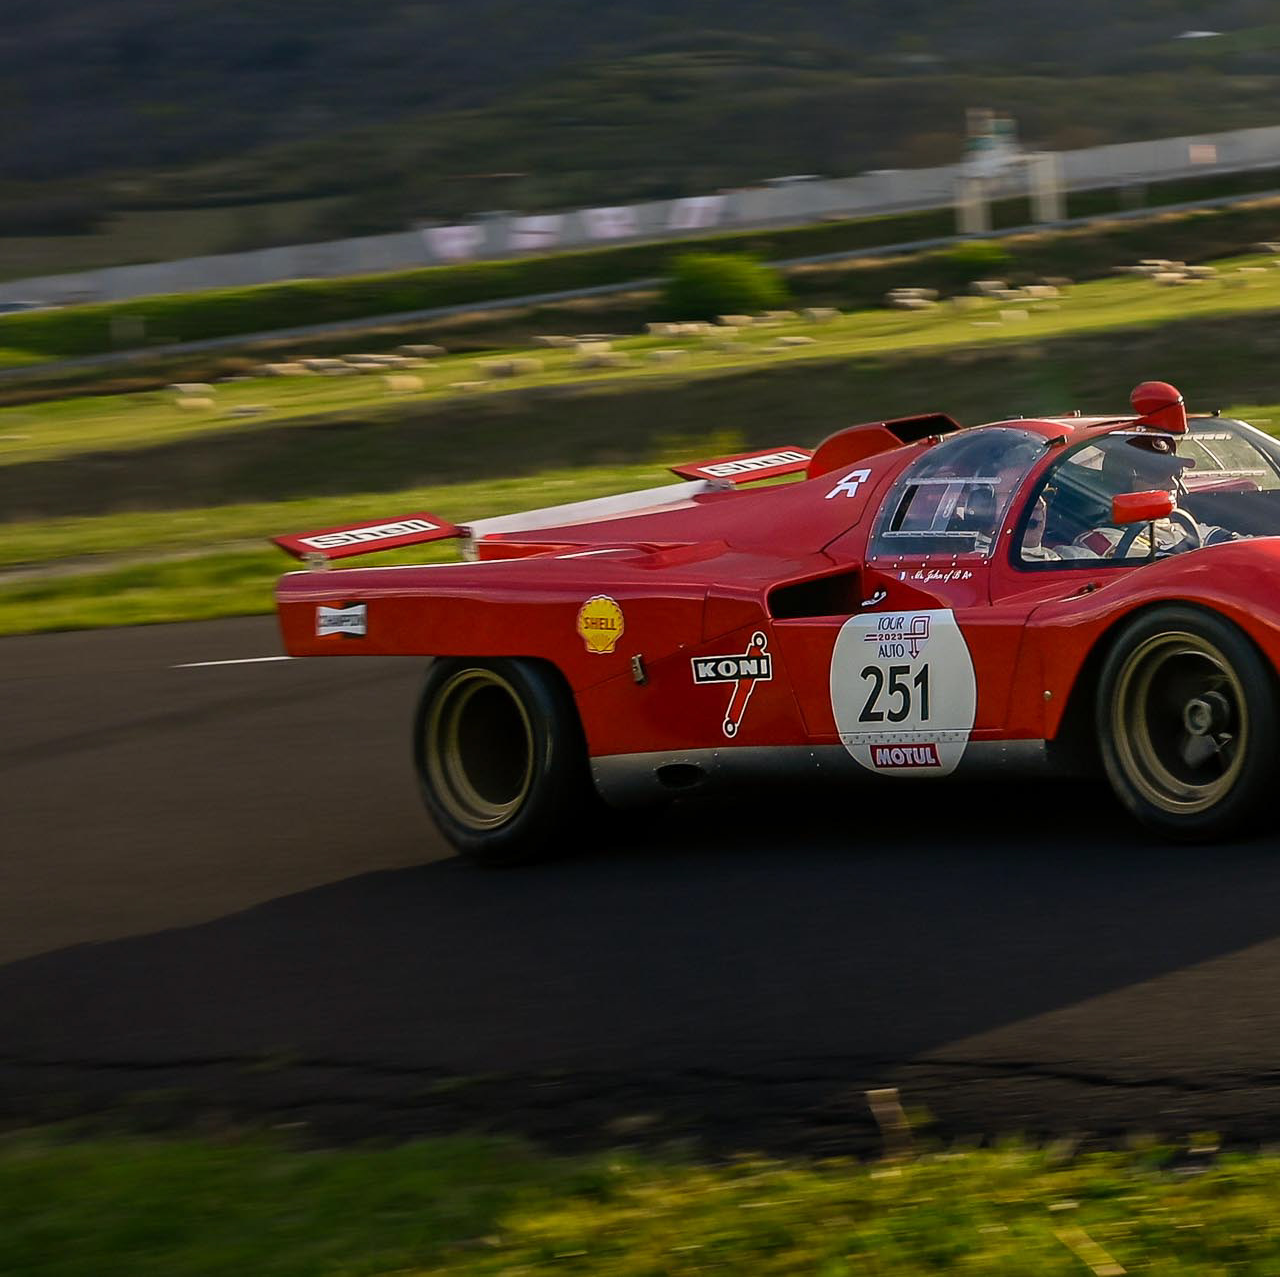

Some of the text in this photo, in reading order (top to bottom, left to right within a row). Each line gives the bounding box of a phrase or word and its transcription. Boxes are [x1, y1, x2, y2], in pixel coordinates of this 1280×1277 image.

[704, 452, 803, 475] Shell
[311, 521, 429, 546] Shell
[584, 617, 617, 630] SHELL
[878, 617, 905, 630] TOUR
[878, 633, 903, 641] 2023
[878, 644, 905, 659] AUTO
[697, 659, 768, 677] KONI
[858, 663, 929, 722] 251
[876, 747, 936, 765] MOTUL
